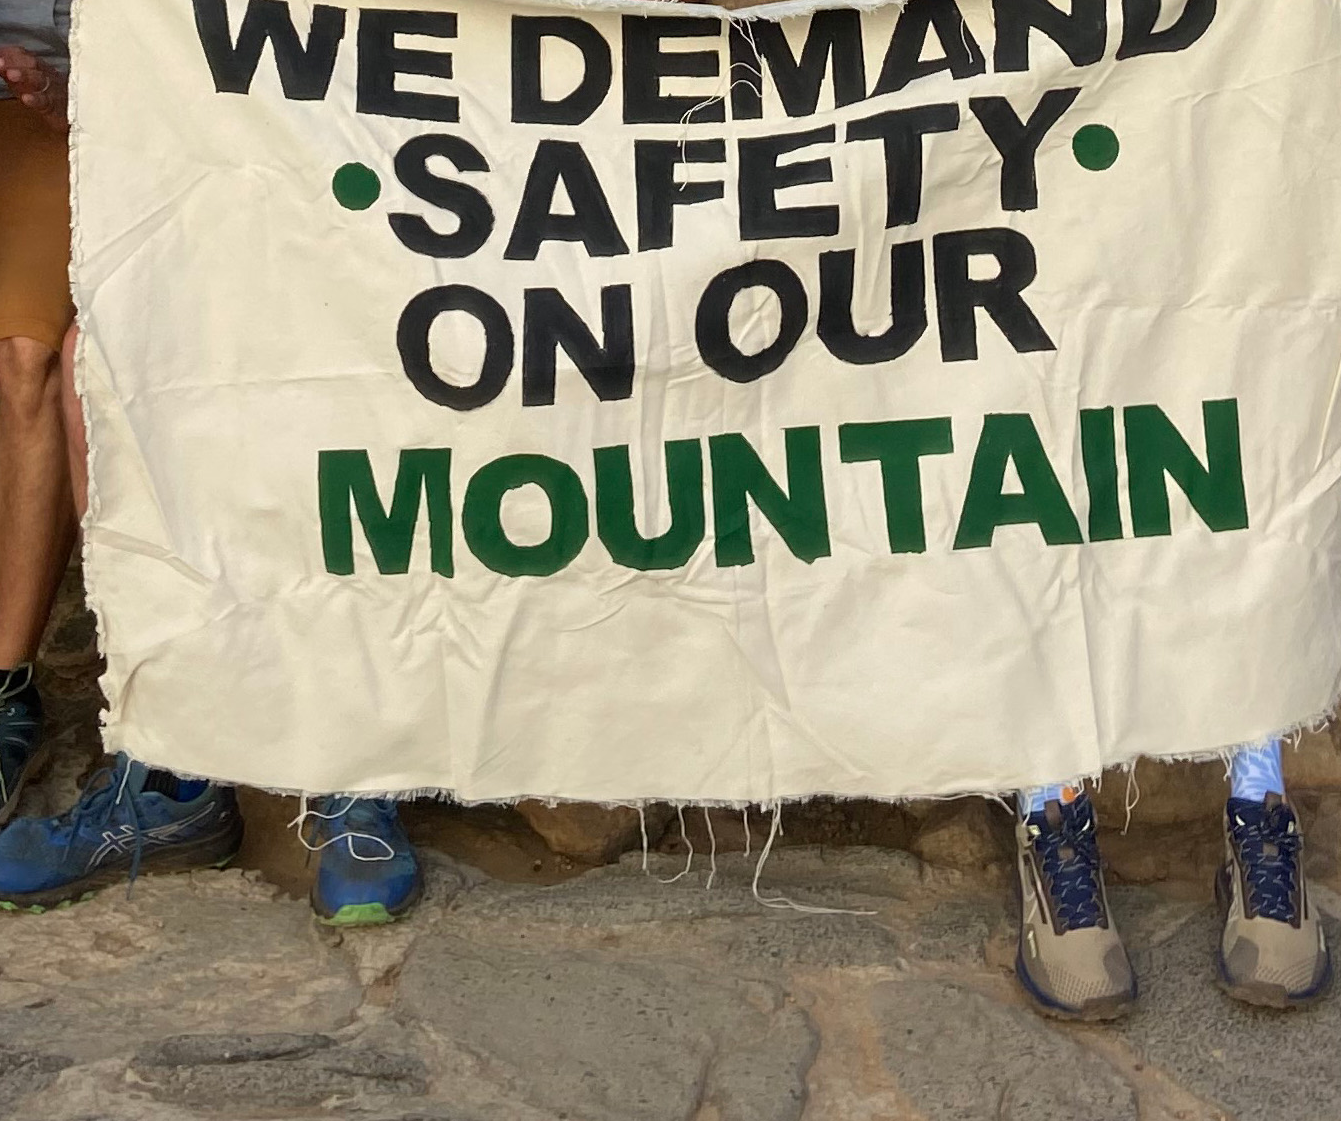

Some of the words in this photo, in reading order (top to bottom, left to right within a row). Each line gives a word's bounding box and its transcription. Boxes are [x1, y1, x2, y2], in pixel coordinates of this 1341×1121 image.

[387, 86, 1081, 262] SAFETY
[396, 282, 635, 412] ON
[693, 226, 1056, 386] OUR
[316, 397, 1251, 579] MOUNTAIN
